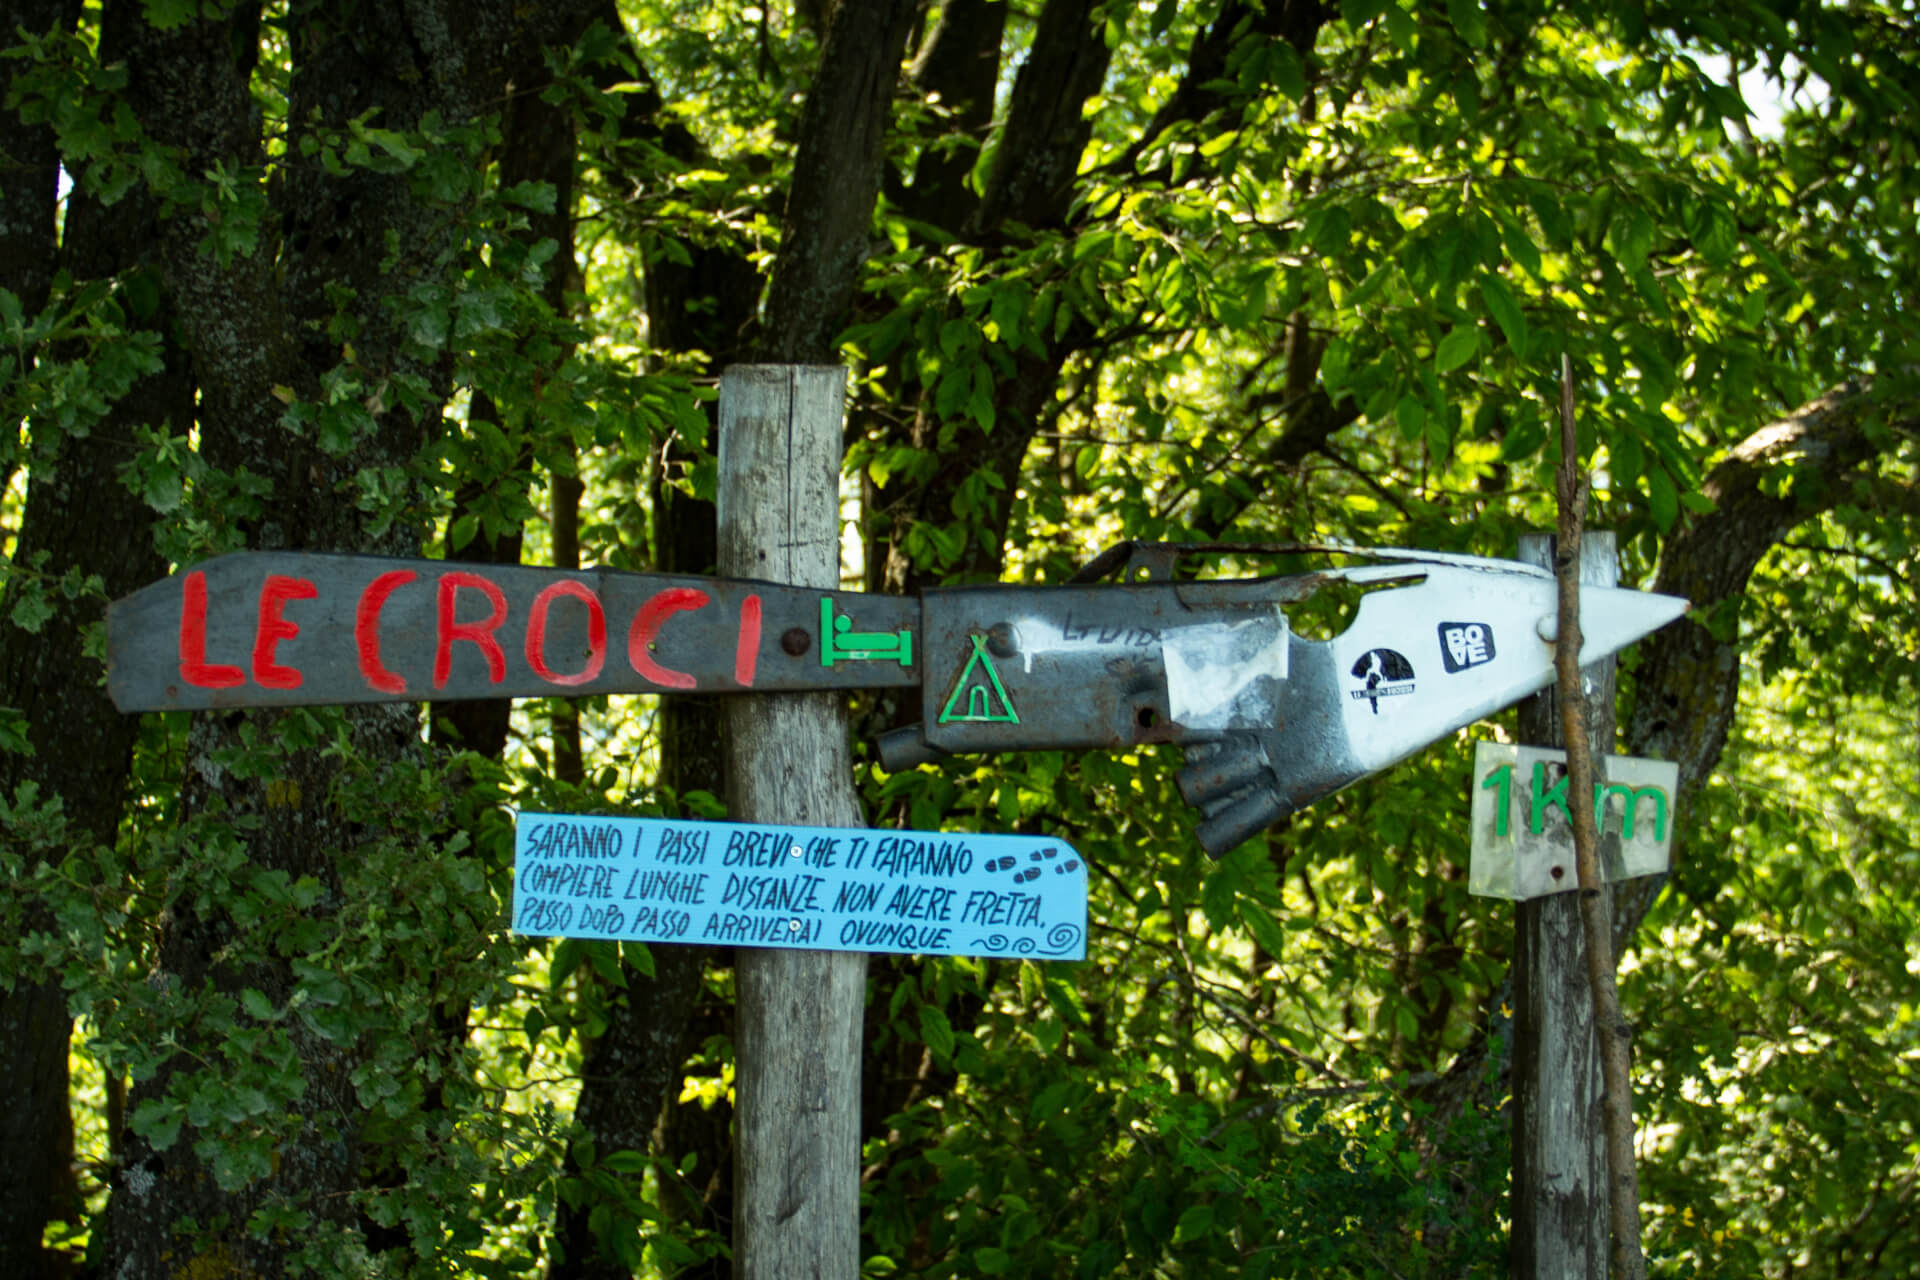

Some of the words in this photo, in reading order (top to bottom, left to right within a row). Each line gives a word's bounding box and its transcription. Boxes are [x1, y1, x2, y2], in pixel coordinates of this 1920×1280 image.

[177, 569, 320, 690] LE
[354, 568, 763, 696] CROCI
[524, 822, 623, 859] SARANNO
[632, 826, 643, 857] I
[655, 828, 710, 866] PASSI
[722, 830, 794, 868] BREVI
[804, 836, 841, 868] CHE
[845, 837, 869, 869] TI
[871, 836, 973, 878] FARANNO
[517, 897, 573, 931] PASSO
[578, 903, 625, 934] DOPO
[630, 907, 690, 939] PASSO
[703, 912, 822, 944] ARRIVERAI
[840, 919, 951, 950] OVUNQUE.
[520, 860, 620, 898] COMPIERE
[624, 869, 709, 905] LUNGHE
[720, 872, 826, 913] DISTANZE.
[832, 880, 884, 914] NON
[884, 885, 956, 922] AVERE
[960, 891, 1046, 928] FRETTA.
